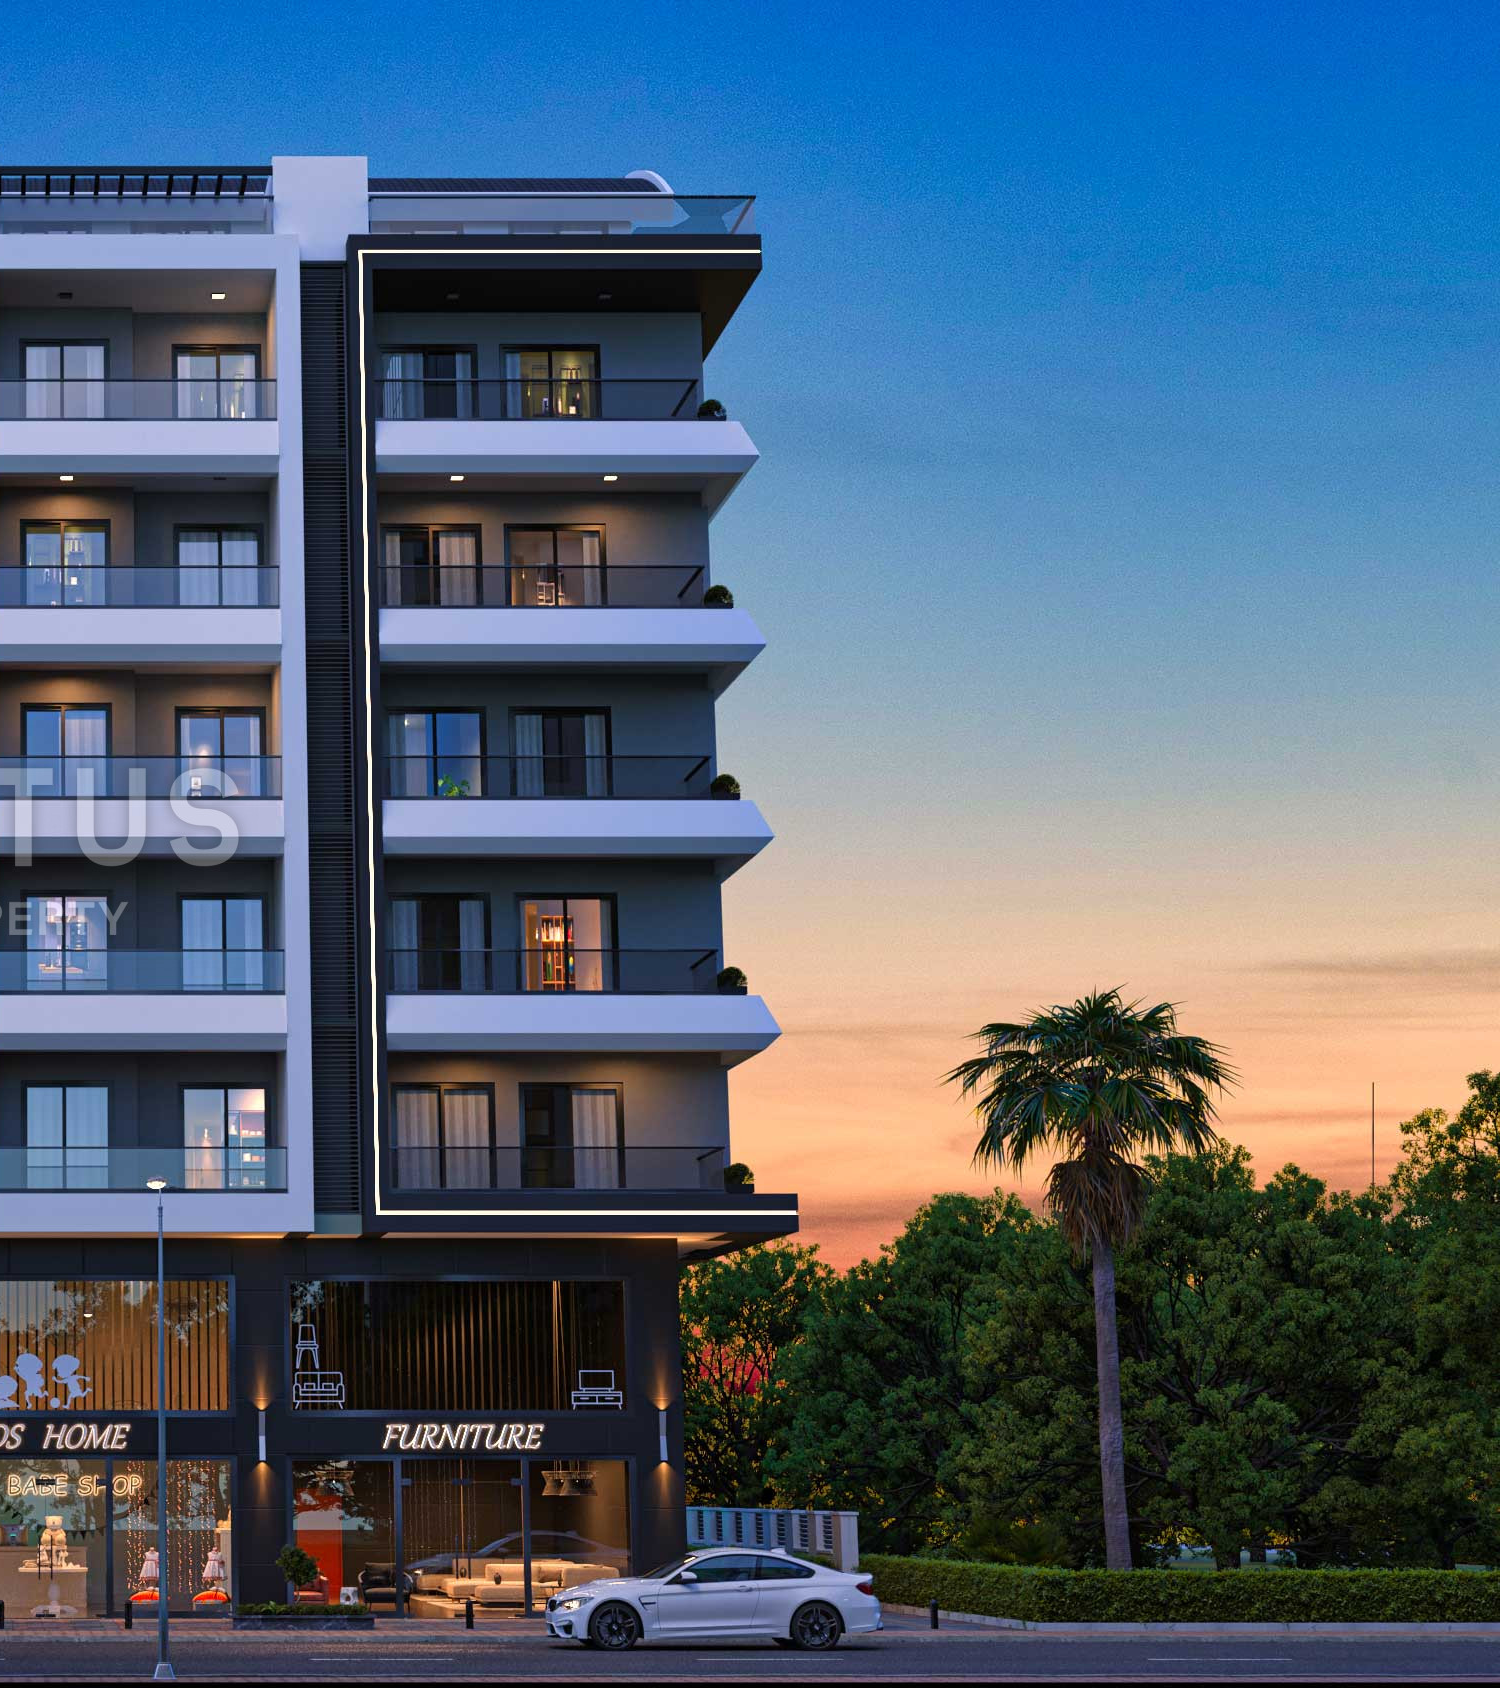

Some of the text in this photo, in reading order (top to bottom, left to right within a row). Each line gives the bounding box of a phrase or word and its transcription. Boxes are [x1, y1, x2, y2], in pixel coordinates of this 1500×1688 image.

[42, 1423, 131, 1450] HOME
[382, 1423, 544, 1450] FURNITURE
[7, 1474, 68, 1497] BABE
